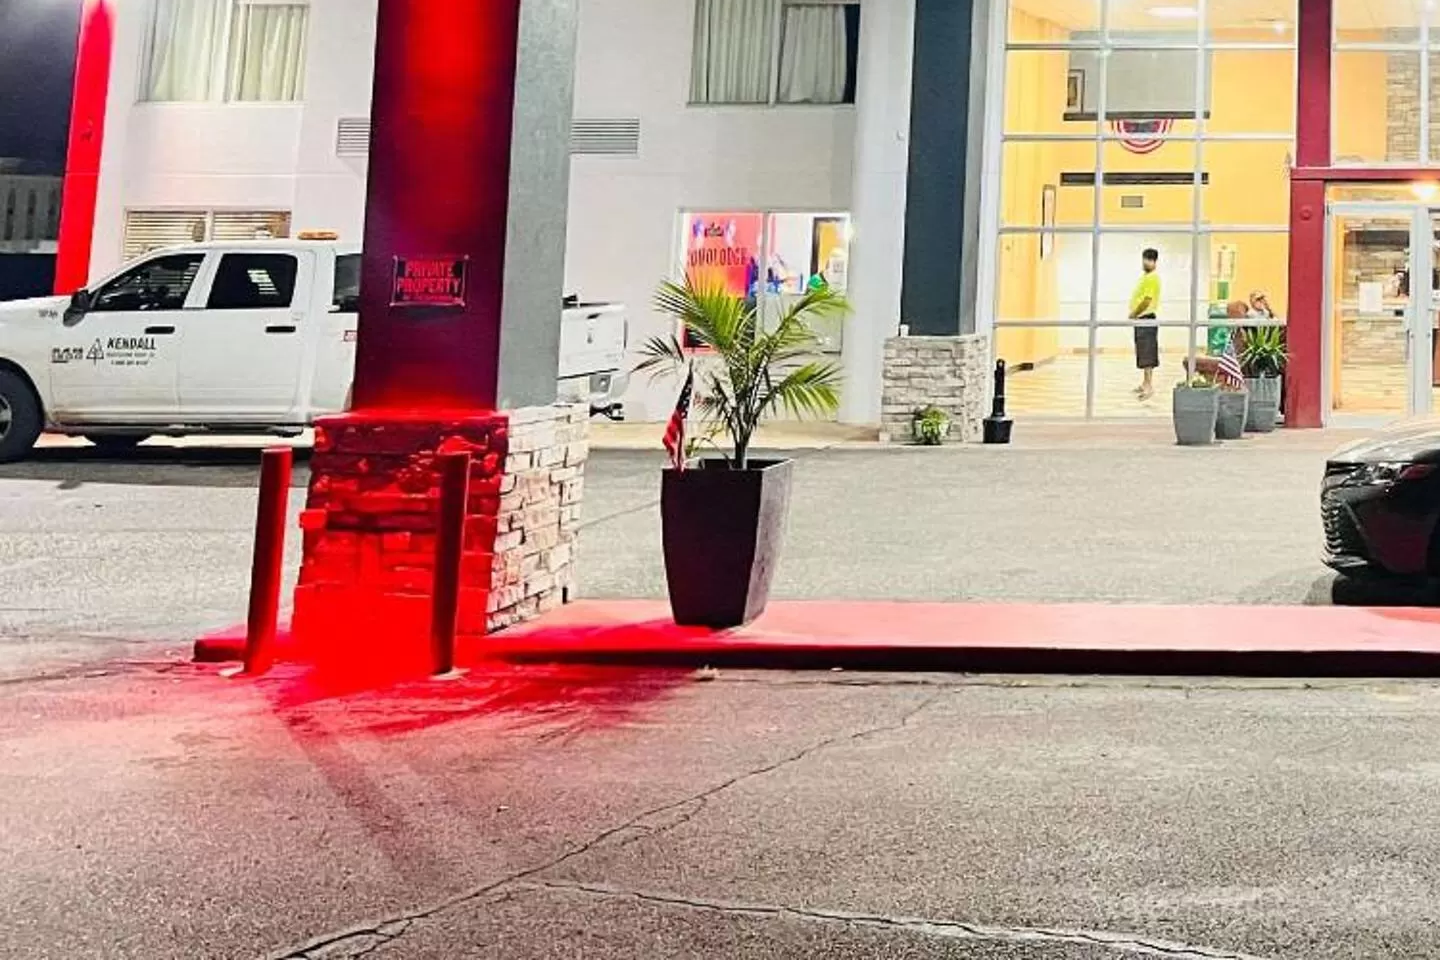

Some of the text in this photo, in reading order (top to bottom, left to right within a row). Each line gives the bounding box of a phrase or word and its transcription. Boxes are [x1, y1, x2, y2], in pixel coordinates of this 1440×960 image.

[404, 260, 455, 277] PRIVATE
[396, 277, 462, 293] PROPERTY
[106, 337, 156, 350] KENDALL
